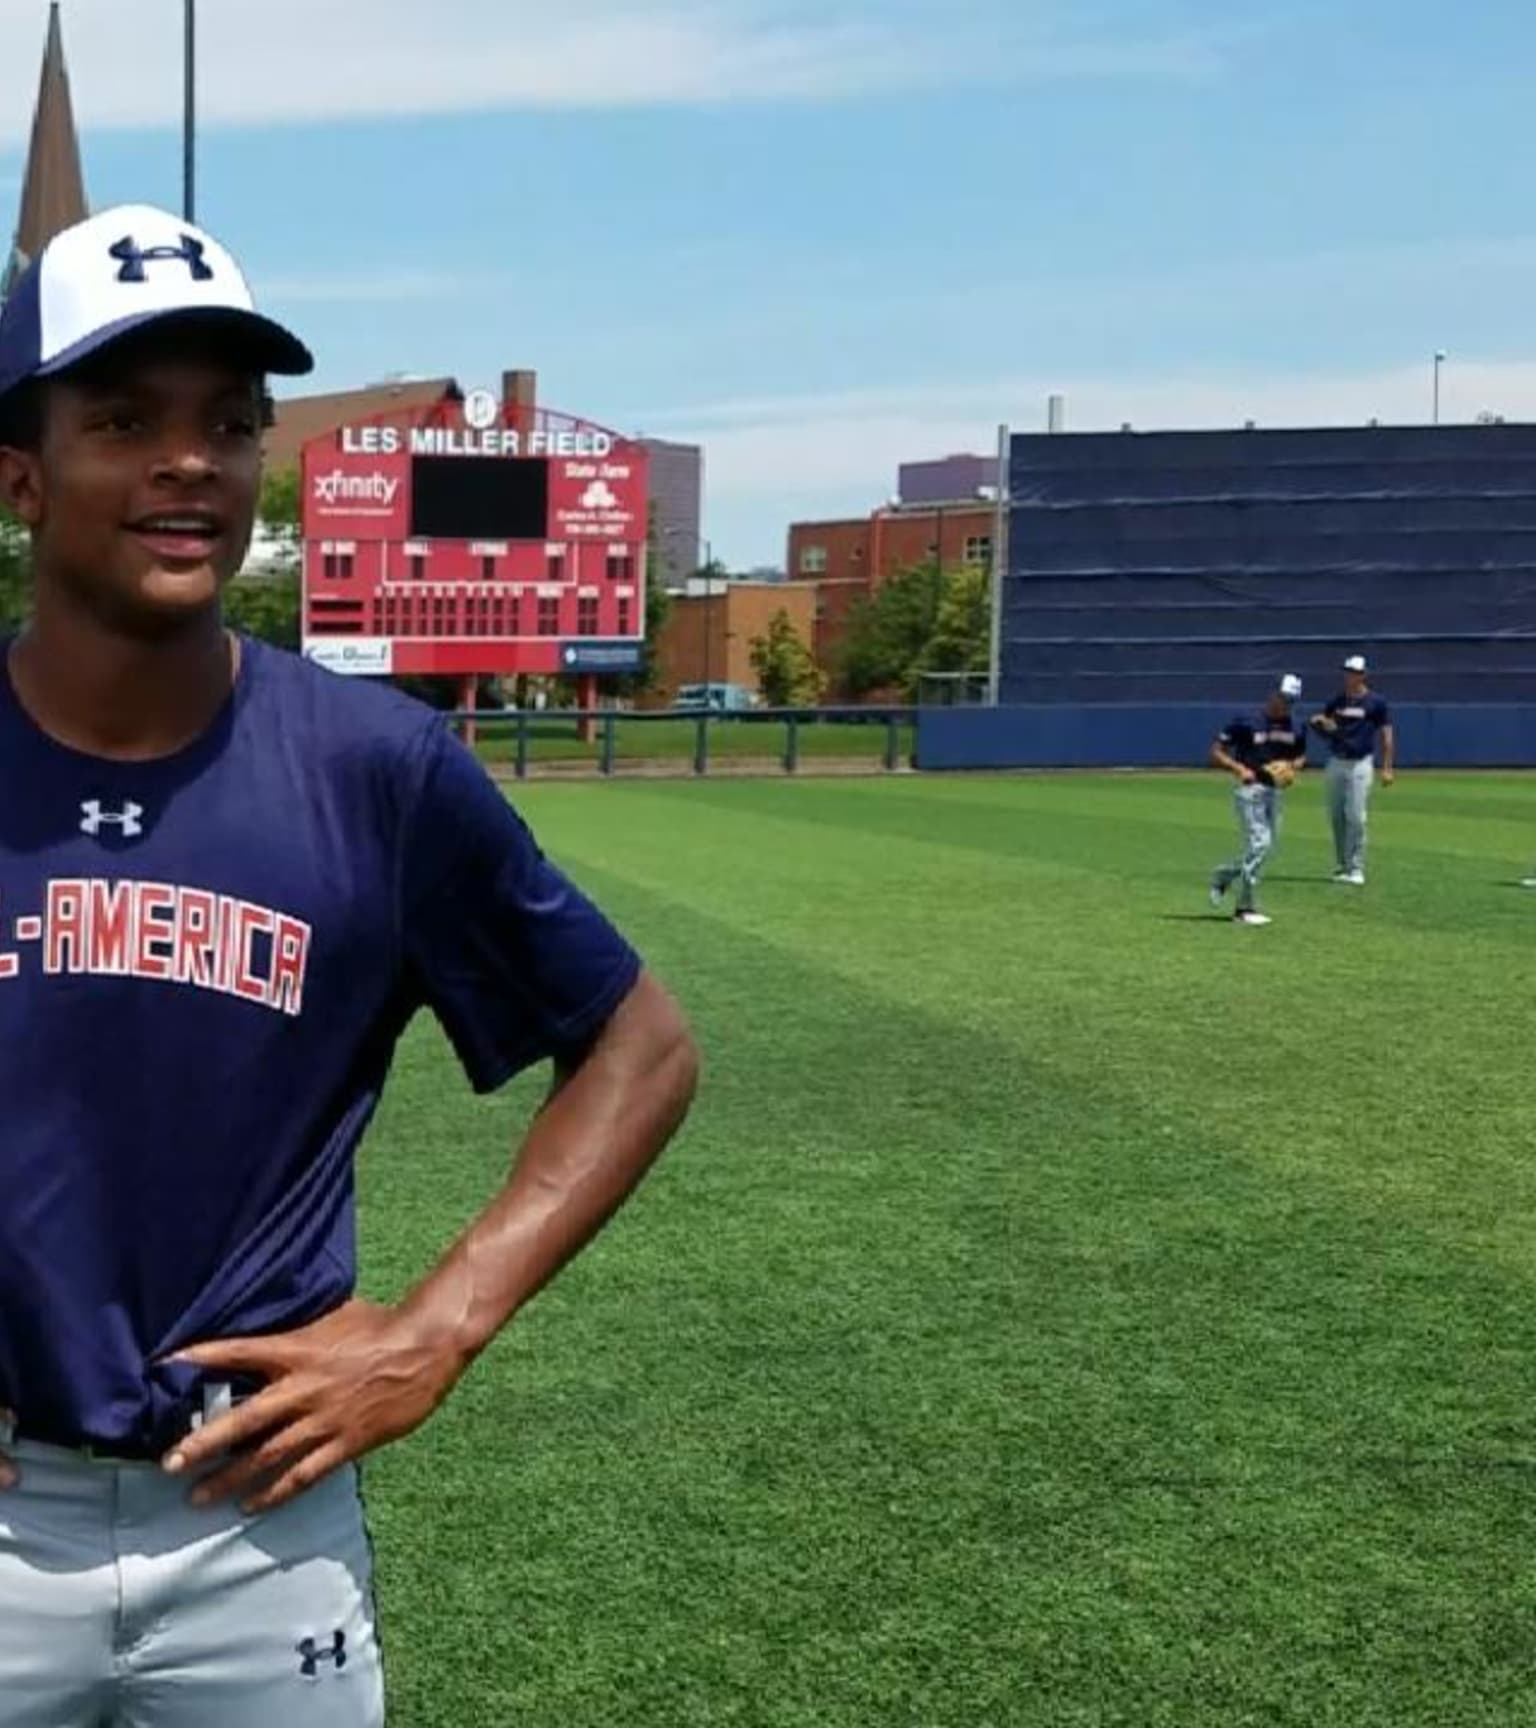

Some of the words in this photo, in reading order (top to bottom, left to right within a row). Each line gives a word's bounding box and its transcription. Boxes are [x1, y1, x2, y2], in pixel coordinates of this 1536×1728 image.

[342, 427, 399, 453] LES
[410, 429, 519, 455] MILLER
[528, 432, 611, 457] FIELD
[314, 470, 398, 504] xfinity
